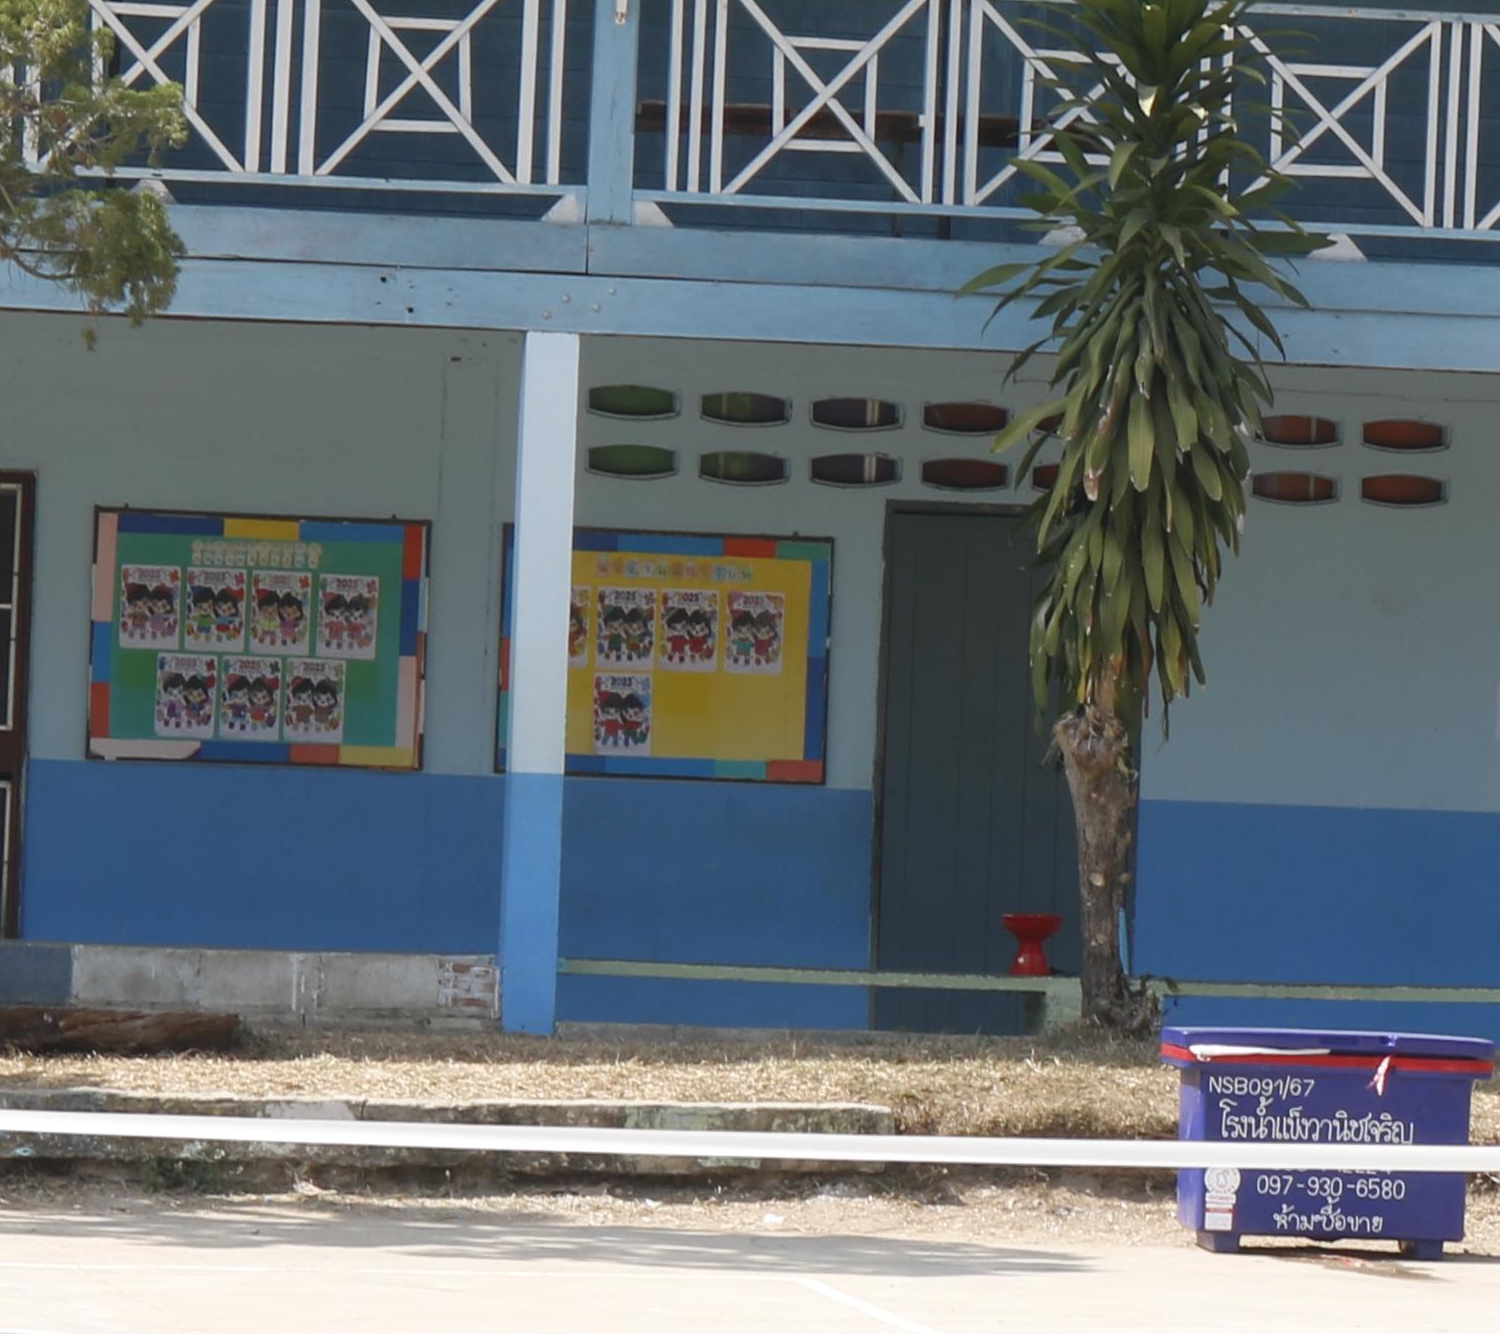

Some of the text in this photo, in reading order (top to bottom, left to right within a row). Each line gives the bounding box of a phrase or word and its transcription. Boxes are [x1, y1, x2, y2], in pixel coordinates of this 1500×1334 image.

[1208, 1075, 1316, 1100] NSB091/67
[1256, 1174, 1406, 1201] 097-930-6580
[1272, 1195, 1384, 1232] ห้ามซื้อขาย
